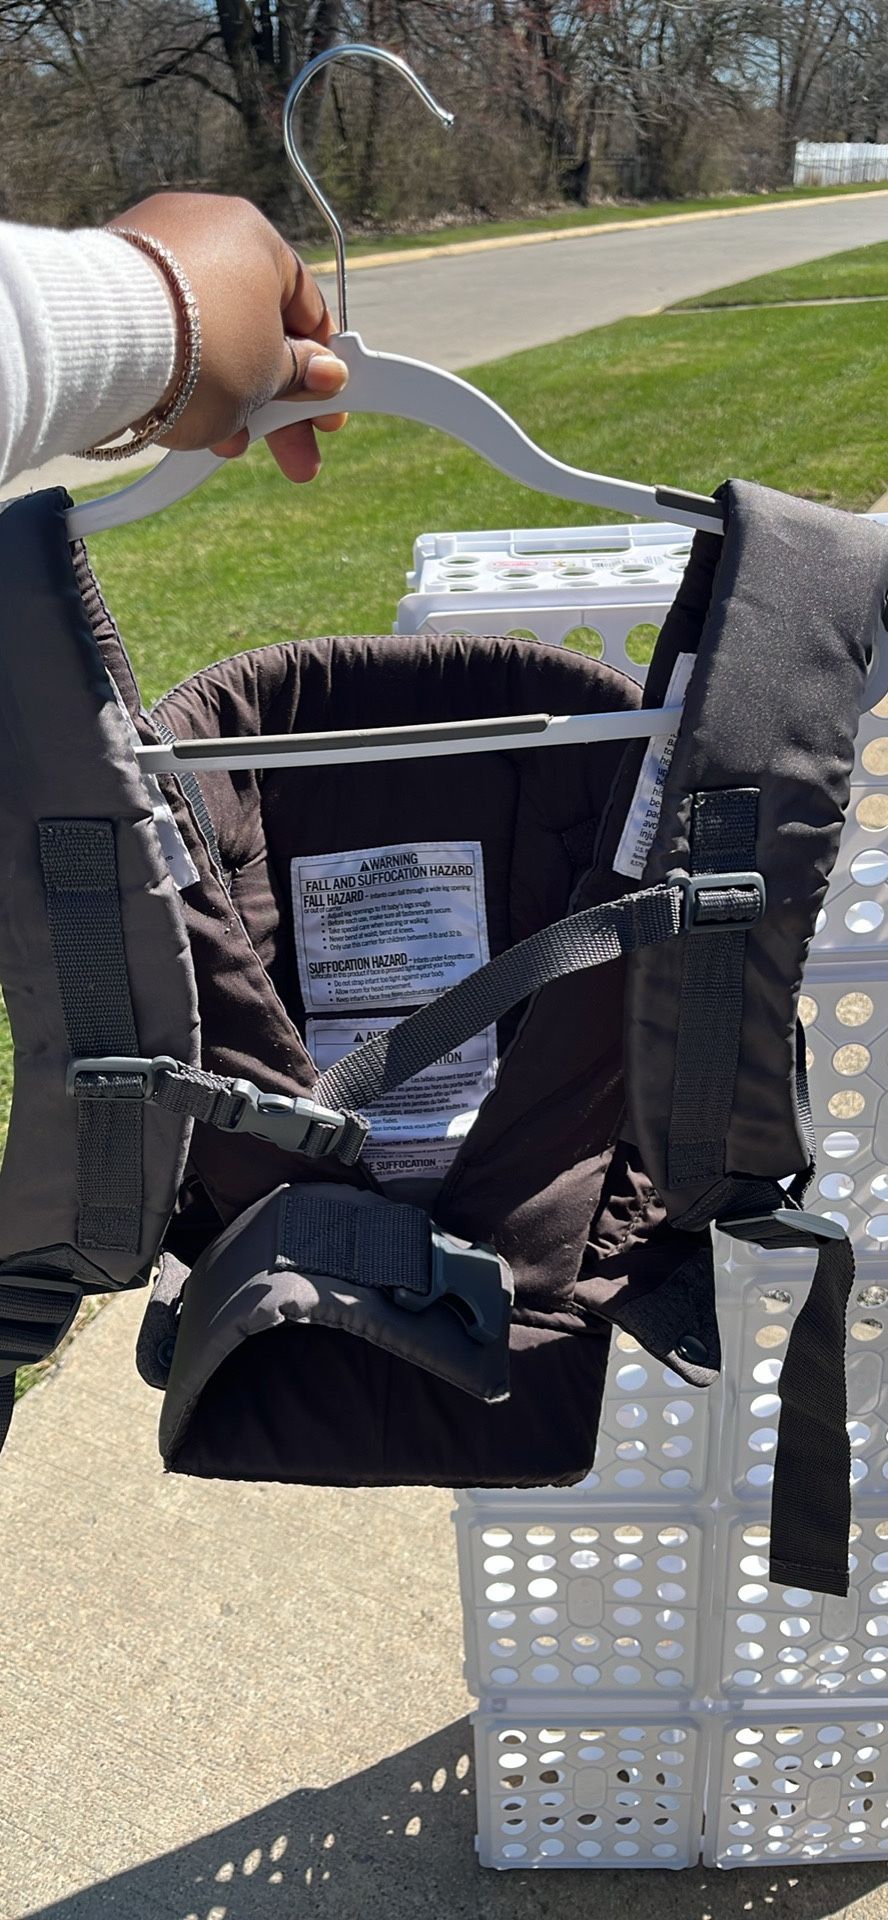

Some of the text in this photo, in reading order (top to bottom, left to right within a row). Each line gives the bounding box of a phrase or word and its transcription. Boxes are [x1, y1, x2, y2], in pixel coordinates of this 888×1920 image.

[369, 853, 418, 871] WARNING
[305, 865, 473, 892] FALL AND SUFFOCATION HAZARD
[303, 894, 325, 908] FALL
[327, 890, 364, 906] HAZARD
[406, 887, 425, 895] through
[352, 907, 374, 916] openings
[401, 909, 425, 917] fasteners
[340, 926, 358, 934] special
[308, 957, 370, 974] SUFFOCATION
[372, 953, 408, 969] HAZARD
[347, 970, 366, 978] product
[351, 979, 364, 987] strap
[376, 1158, 436, 1170] SUFFOCATION
